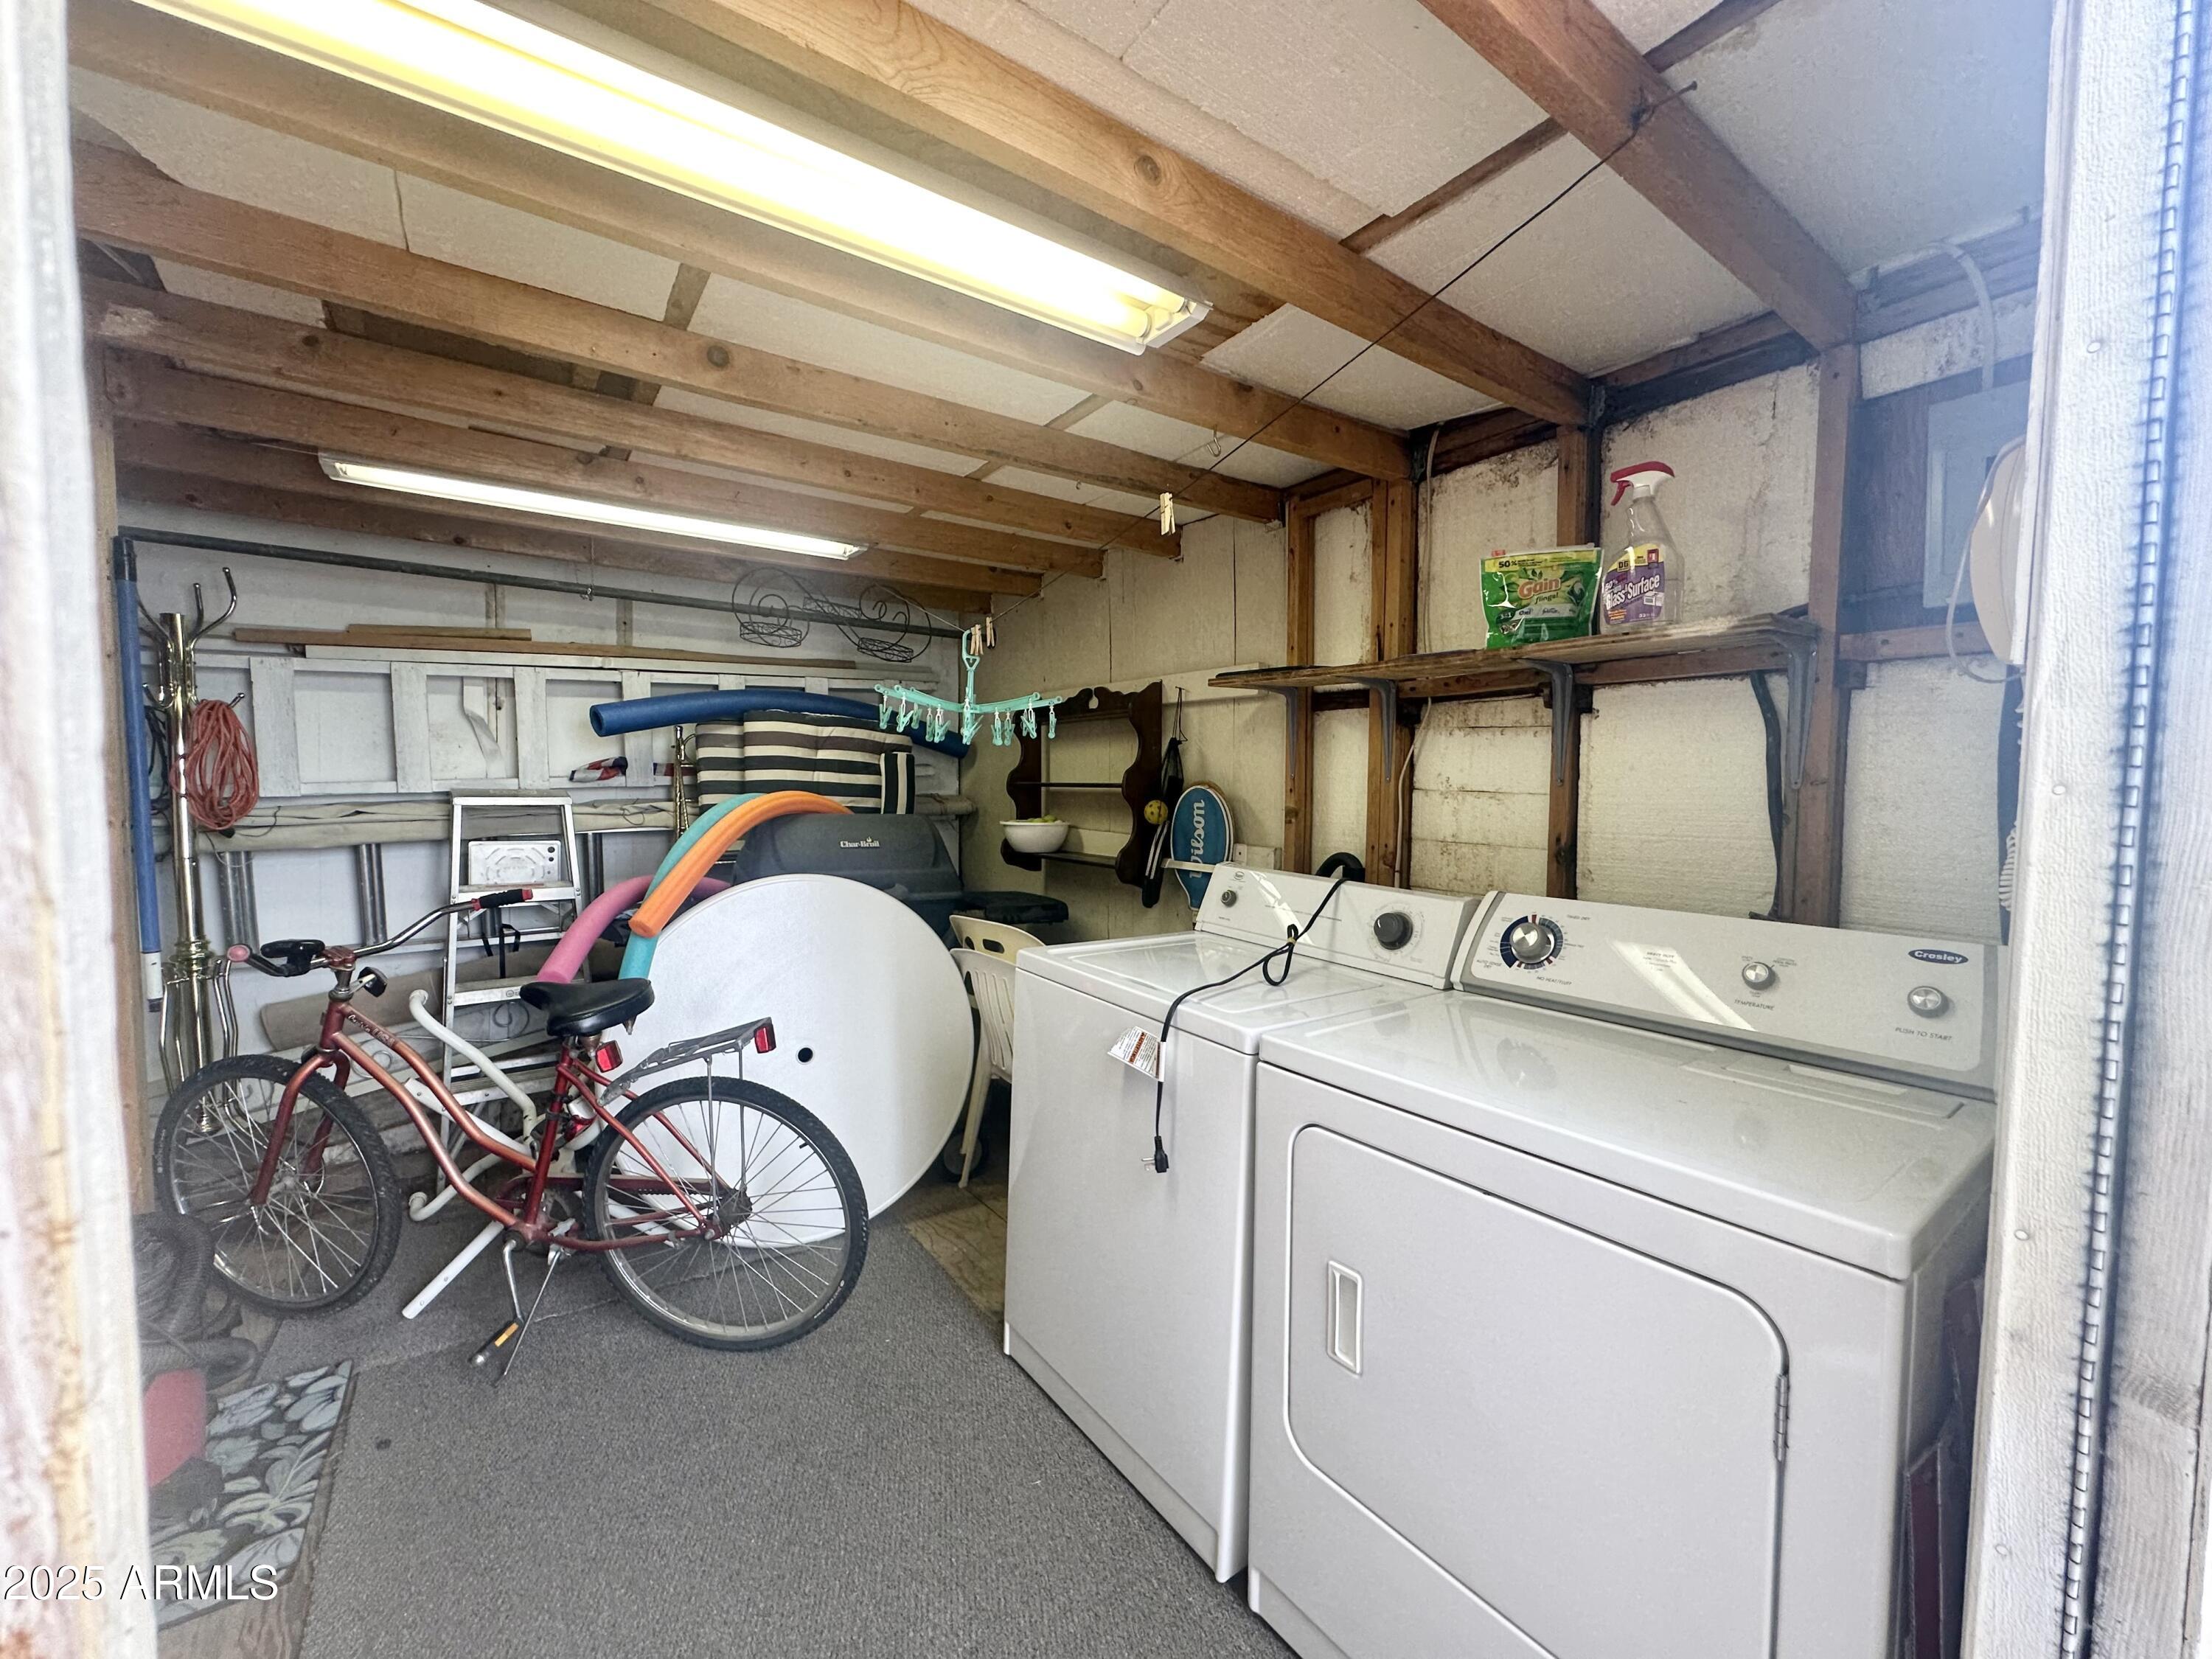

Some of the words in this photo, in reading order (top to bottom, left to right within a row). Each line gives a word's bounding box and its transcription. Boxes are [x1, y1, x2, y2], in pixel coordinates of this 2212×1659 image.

[1618, 560, 1629, 568] DG
[1518, 578, 1561, 599] Gain
[1606, 589, 1626, 611] Glass
[1627, 574, 1660, 599] Surface
[840, 840, 880, 848] Char-Broil
[1914, 950, 1963, 963] Crosley
[1734, 999, 1775, 1011] TEMPERATURE
[1930, 1032, 1953, 1041] START
